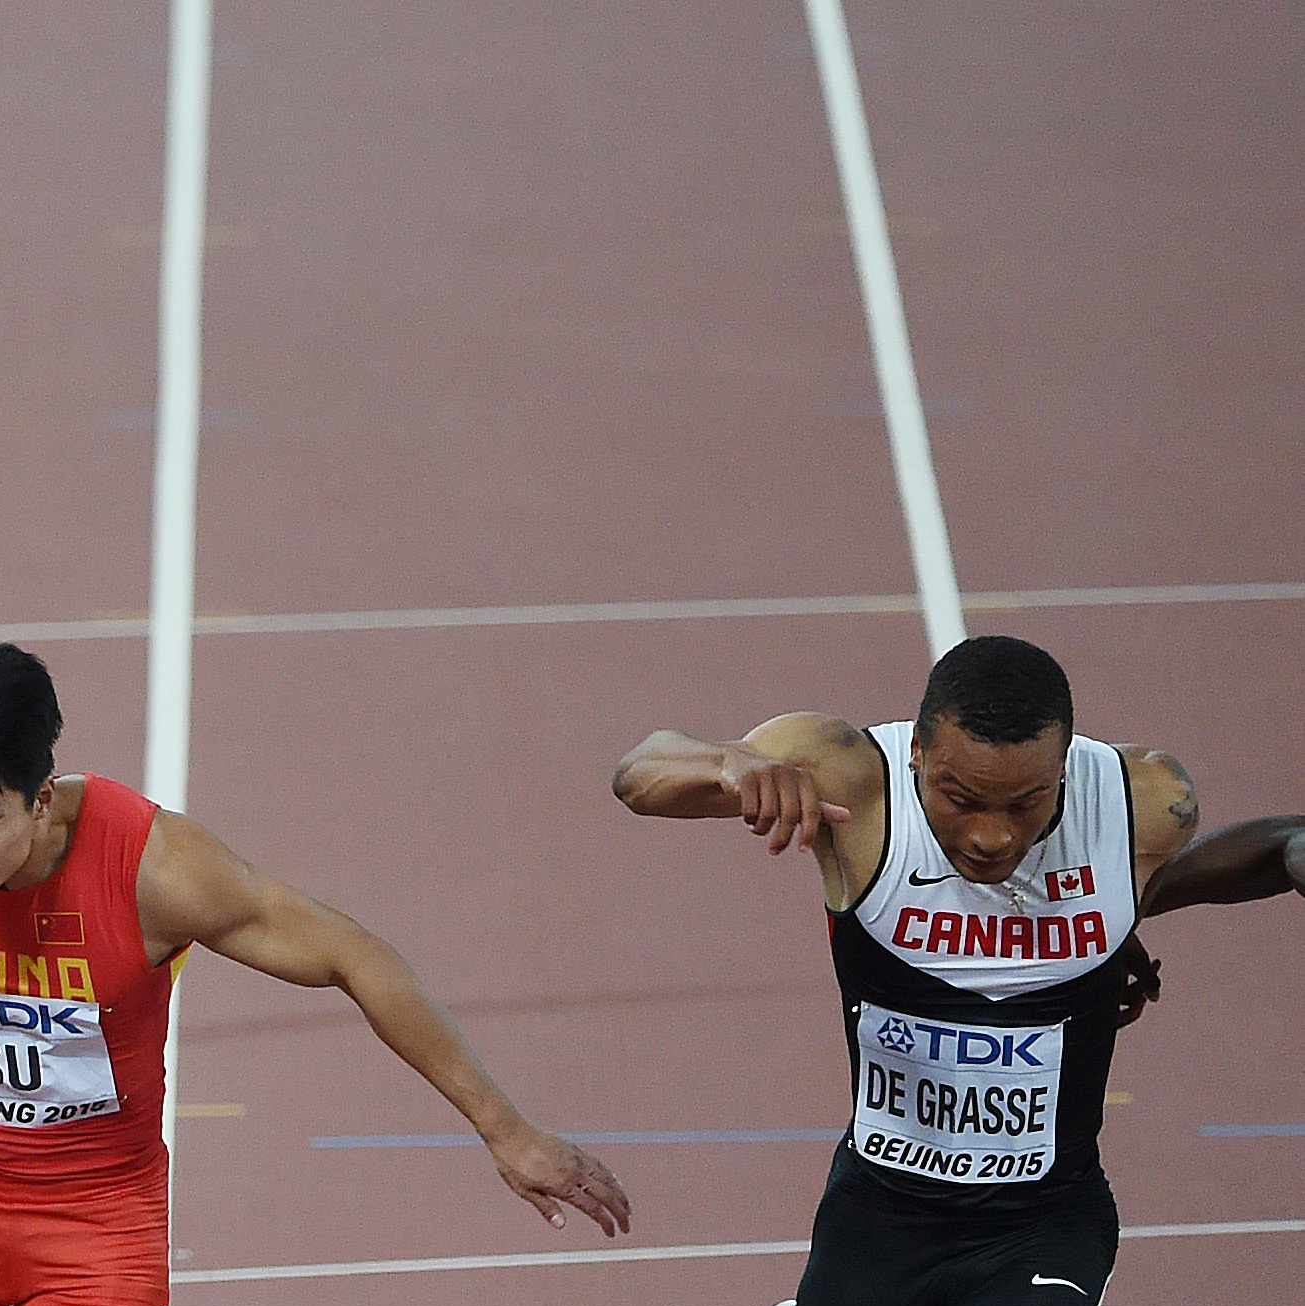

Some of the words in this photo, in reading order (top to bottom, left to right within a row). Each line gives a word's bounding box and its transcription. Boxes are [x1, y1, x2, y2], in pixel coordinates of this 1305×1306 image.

[891, 906, 1107, 959] CANADA
[914, 1023, 1045, 1067] TDK
[866, 1060, 905, 1118] DE
[916, 1078, 1049, 1136] GRASSE
[864, 1132, 973, 1177] BEIJING
[976, 1151, 1045, 1178] 2015
